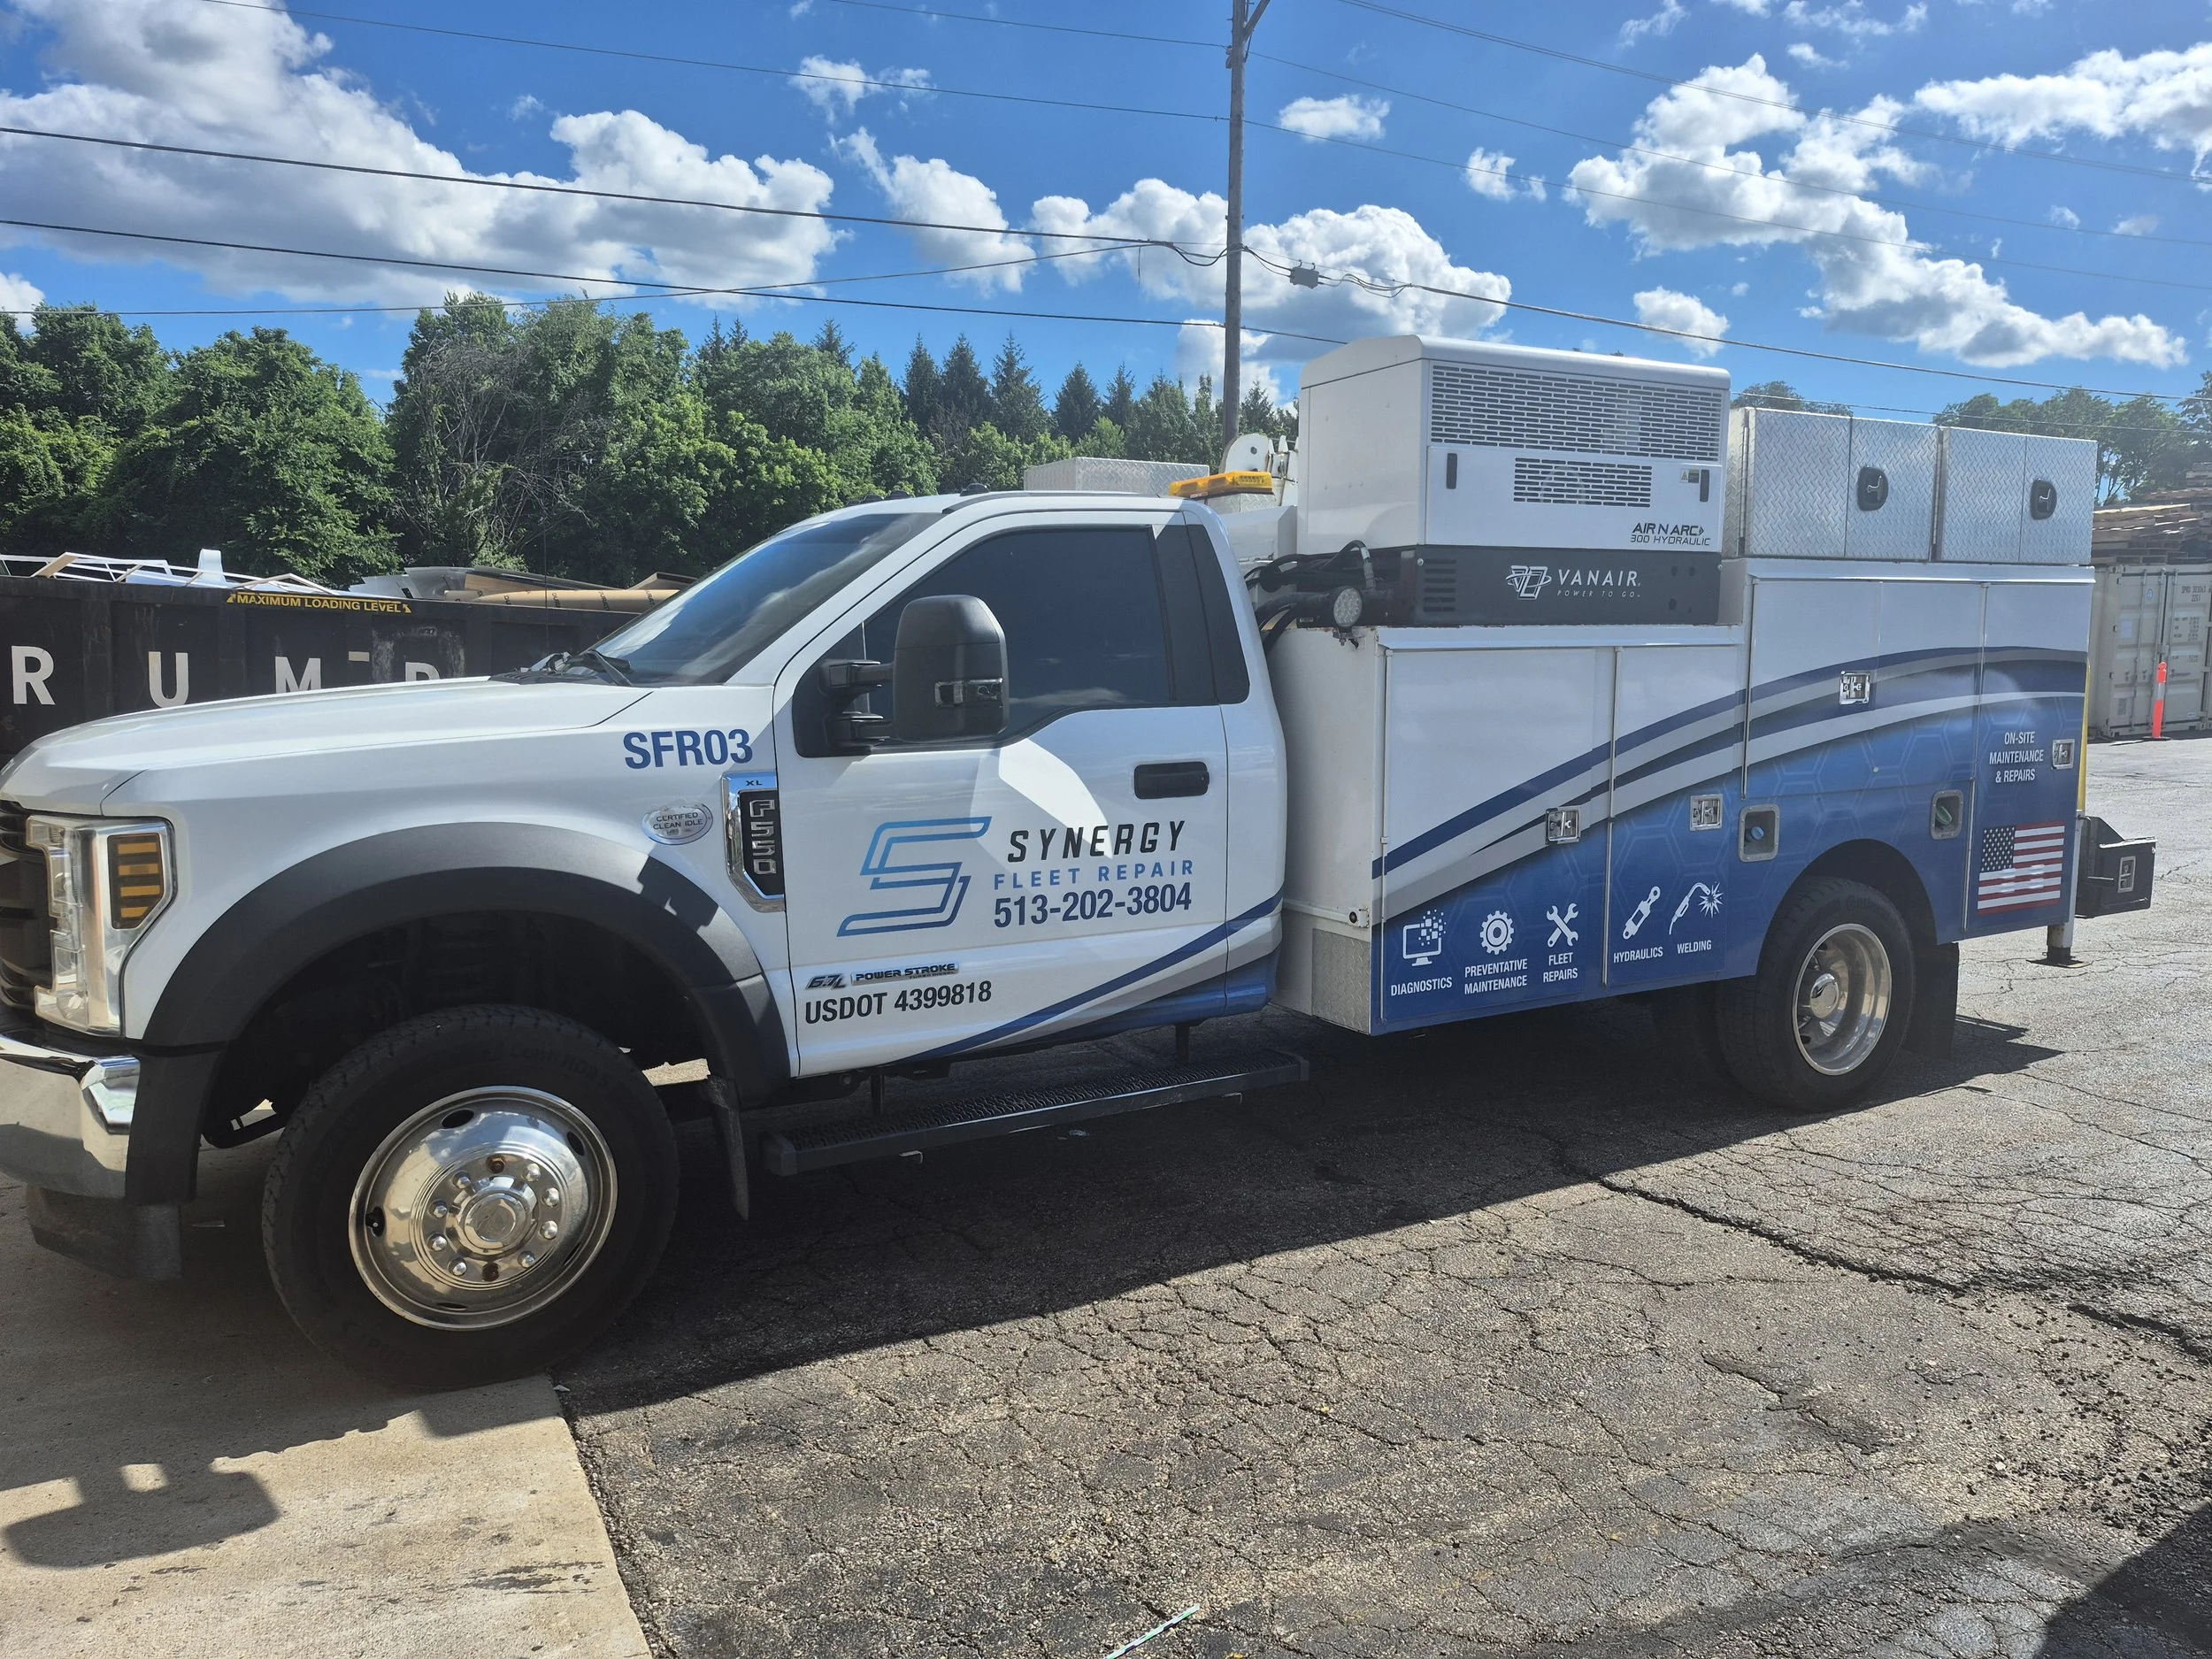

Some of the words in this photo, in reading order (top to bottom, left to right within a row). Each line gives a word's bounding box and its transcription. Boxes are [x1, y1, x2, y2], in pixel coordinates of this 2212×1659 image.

[1632, 522, 1656, 534] AIR
[1657, 523, 1670, 534] N
[1670, 524, 1700, 536] ARC
[1630, 534, 1650, 543] 300
[1653, 535, 1711, 546] HYDRAULIC
[1557, 569, 1639, 587] VANAIR
[1601, 589, 1614, 598] TO
[236, 594, 302, 608] MAXIMUM
[303, 597, 361, 611] LOADING
[364, 601, 402, 613] LEVEL
[2004, 731, 2036, 745] ON-SITE
[622, 728, 753, 770] SFR03
[1989, 749, 2045, 765] MAINTENANCE
[1995, 770, 2002, 783] &
[2003, 768, 2036, 783] REPAIRS
[652, 821, 681, 831] CLEAN
[684, 818, 703, 827] IDLE
[656, 811, 699, 823] CERTIFIED
[1007, 820, 1186, 864] SYNERGY
[994, 866, 1081, 891] FLEET
[1098, 859, 1194, 882] REPAIR
[994, 882, 1193, 928] 513-202-3804
[1613, 946, 1663, 964] HYDRAULICS
[1677, 940, 1712, 955] WELDING
[1463, 958, 1528, 978] PREVENTATIVE
[1548, 952, 1574, 966] FLEET
[855, 969, 902, 982] POWER
[903, 963, 956, 976] STROKE
[1542, 967, 1578, 984] REPAIRS
[1390, 976, 1453, 996] DIAGNOSTICS
[1463, 974, 1528, 995] MAINTENANCE
[804, 992, 888, 1025] USDOT
[894, 979, 993, 1012] 4399818
